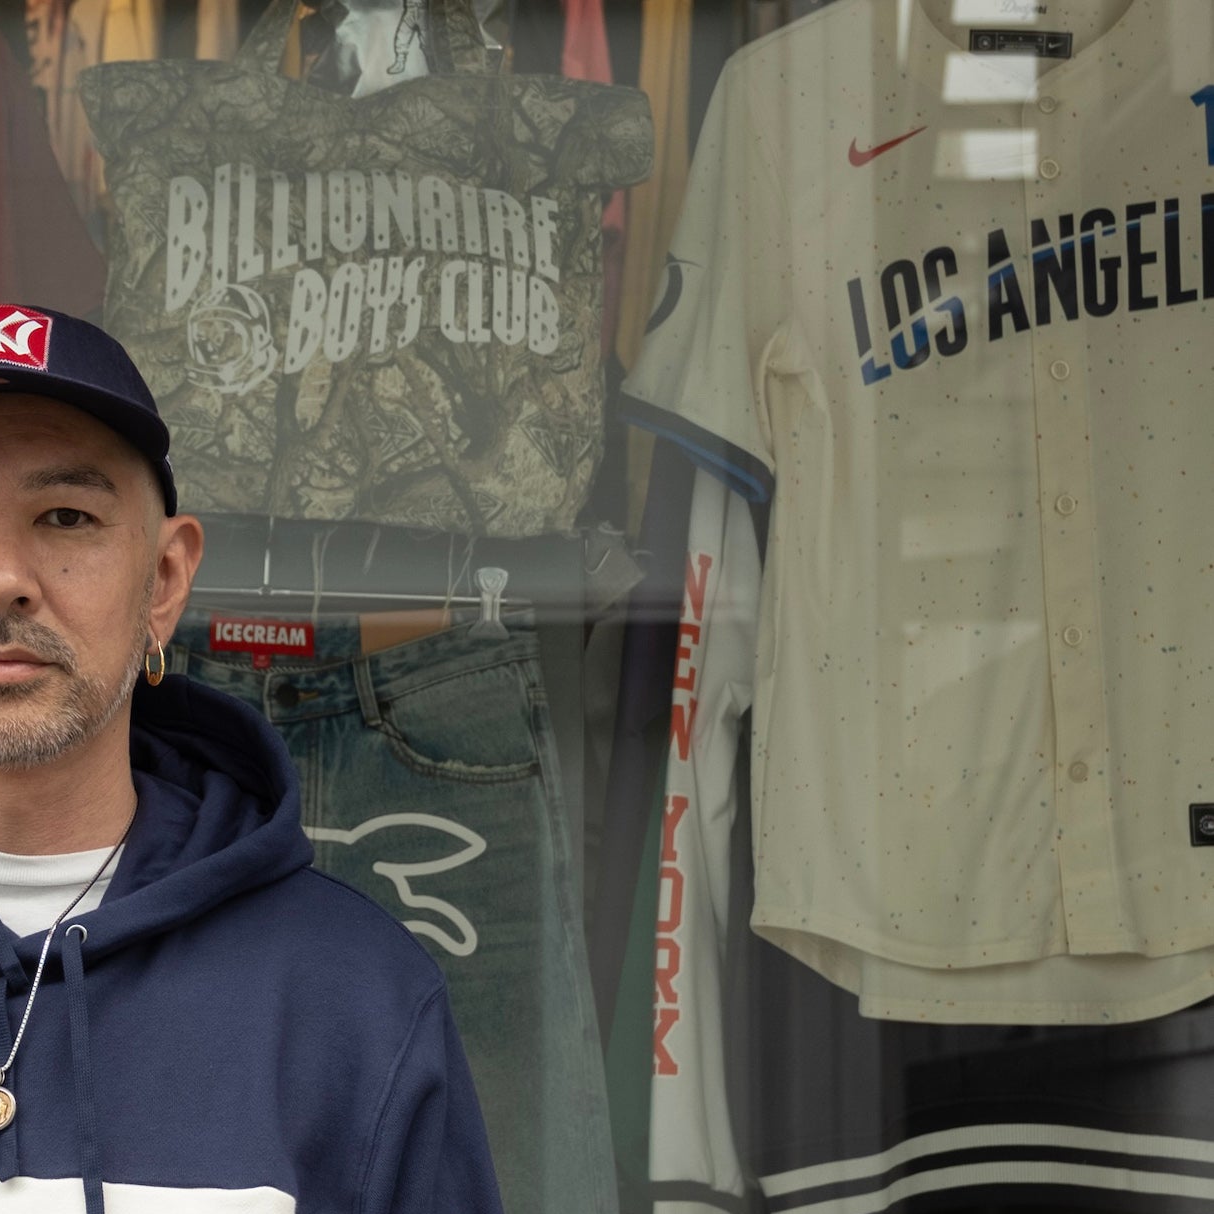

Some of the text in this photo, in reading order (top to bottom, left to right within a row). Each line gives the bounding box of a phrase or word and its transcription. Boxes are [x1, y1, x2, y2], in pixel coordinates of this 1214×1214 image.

[166, 163, 560, 312] BILLIONAIRE
[285, 256, 560, 375] BOYS CLUB
[847, 246, 968, 386] LOS
[215, 622, 306, 647] ICECREAM
[652, 795, 689, 1076] YORK
